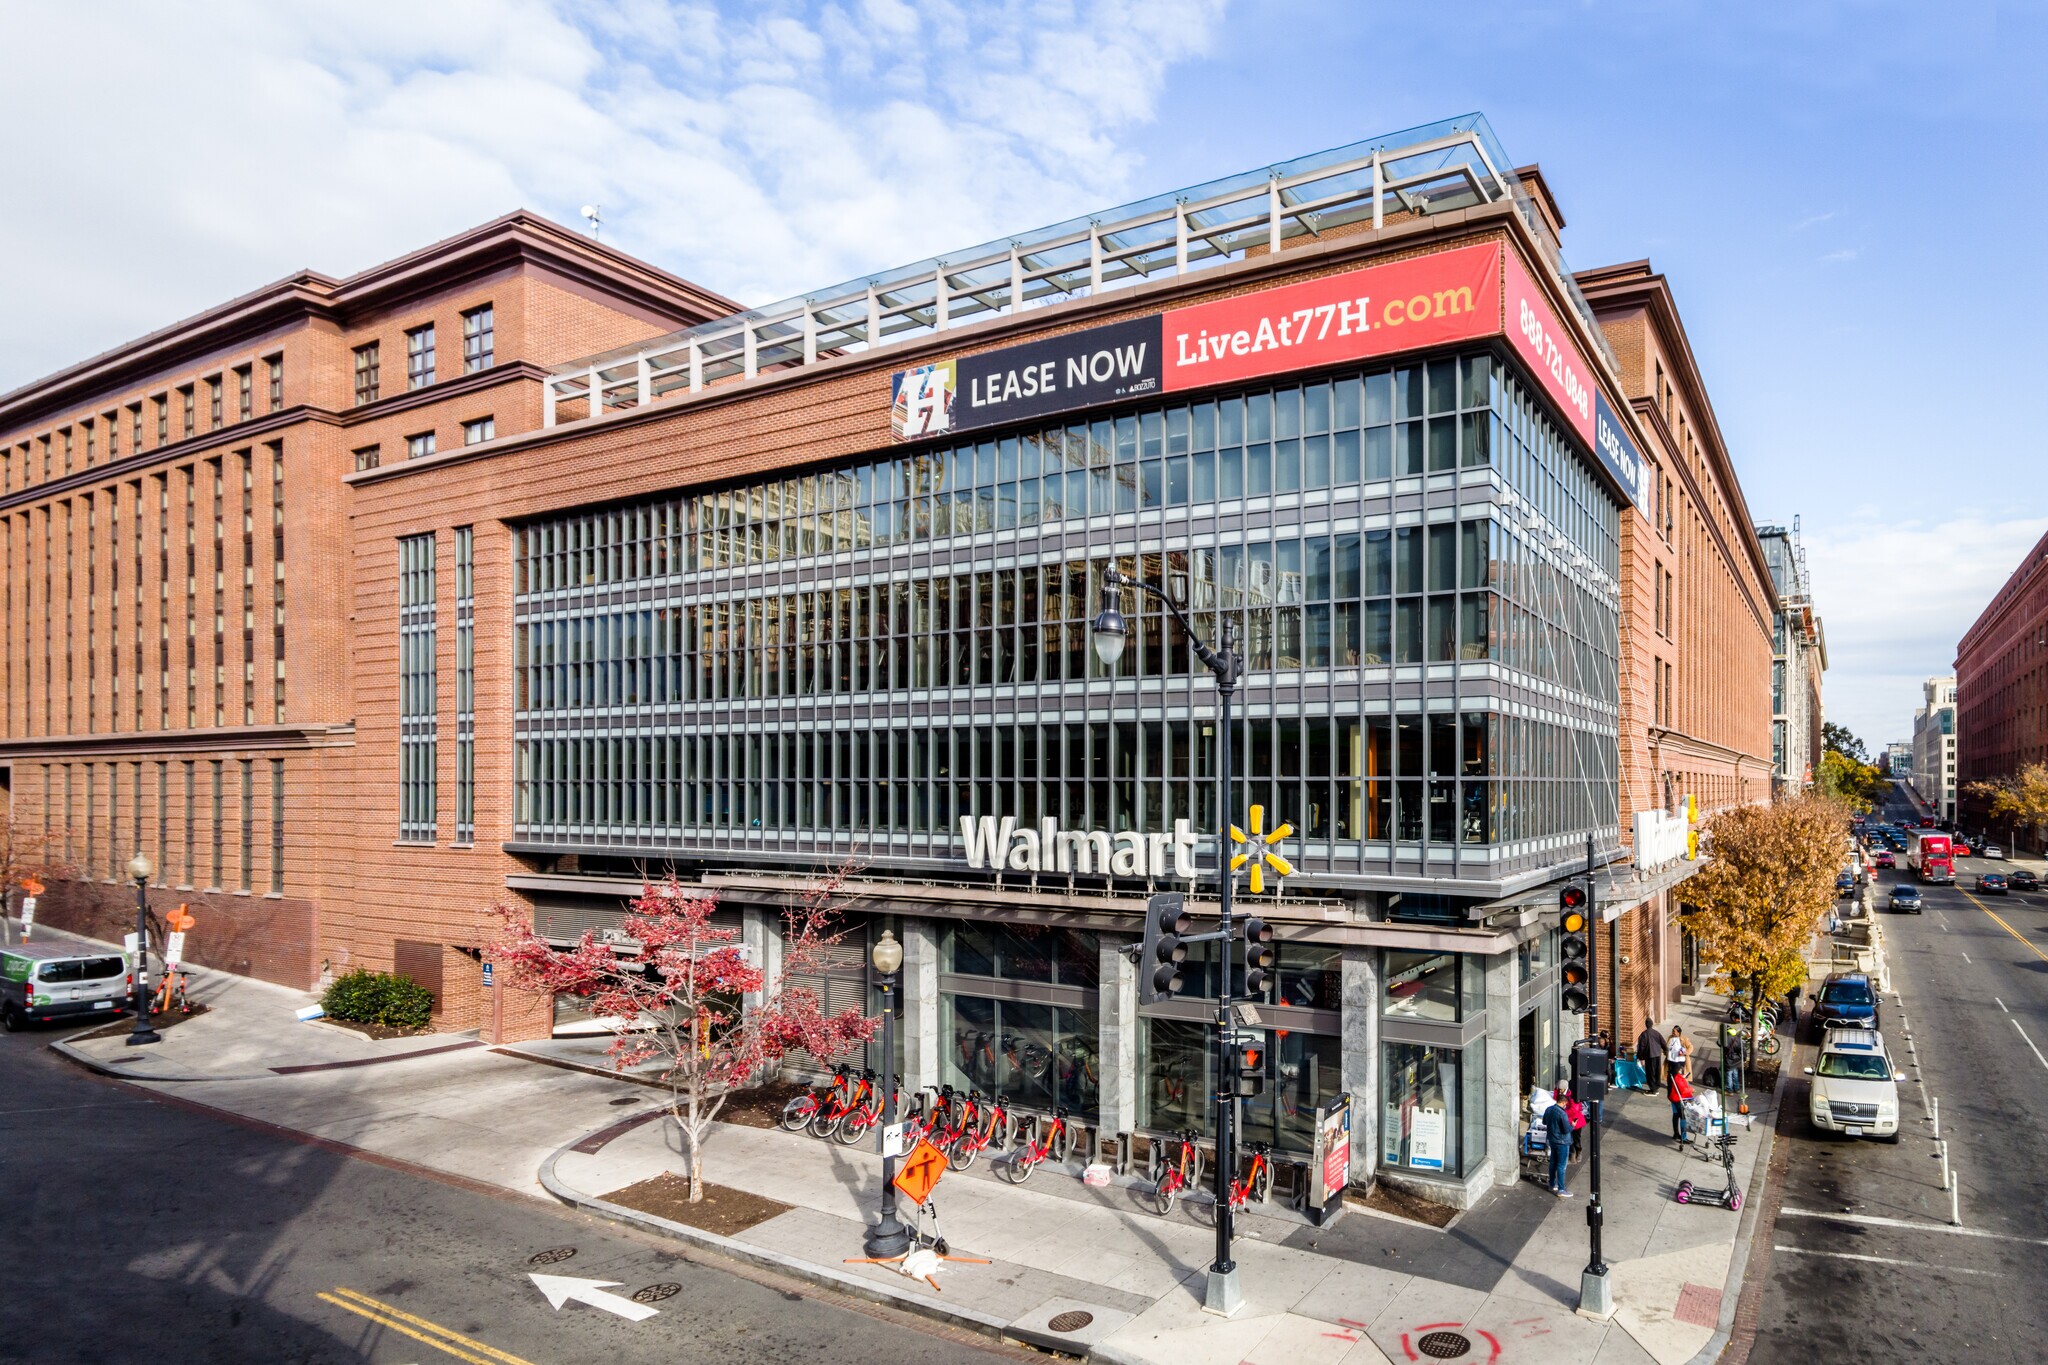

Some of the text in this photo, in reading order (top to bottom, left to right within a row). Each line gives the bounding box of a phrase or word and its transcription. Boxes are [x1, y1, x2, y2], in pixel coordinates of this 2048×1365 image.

[1176, 286, 1475, 367] LiveAt77H.com
[1520, 299, 1588, 420] 888.721.0848
[971, 341, 1147, 408] LEASE NOW
[1598, 414, 1620, 466] LEASE
[1620, 449, 1636, 488] NOW
[960, 815, 1198, 878] Walmart
